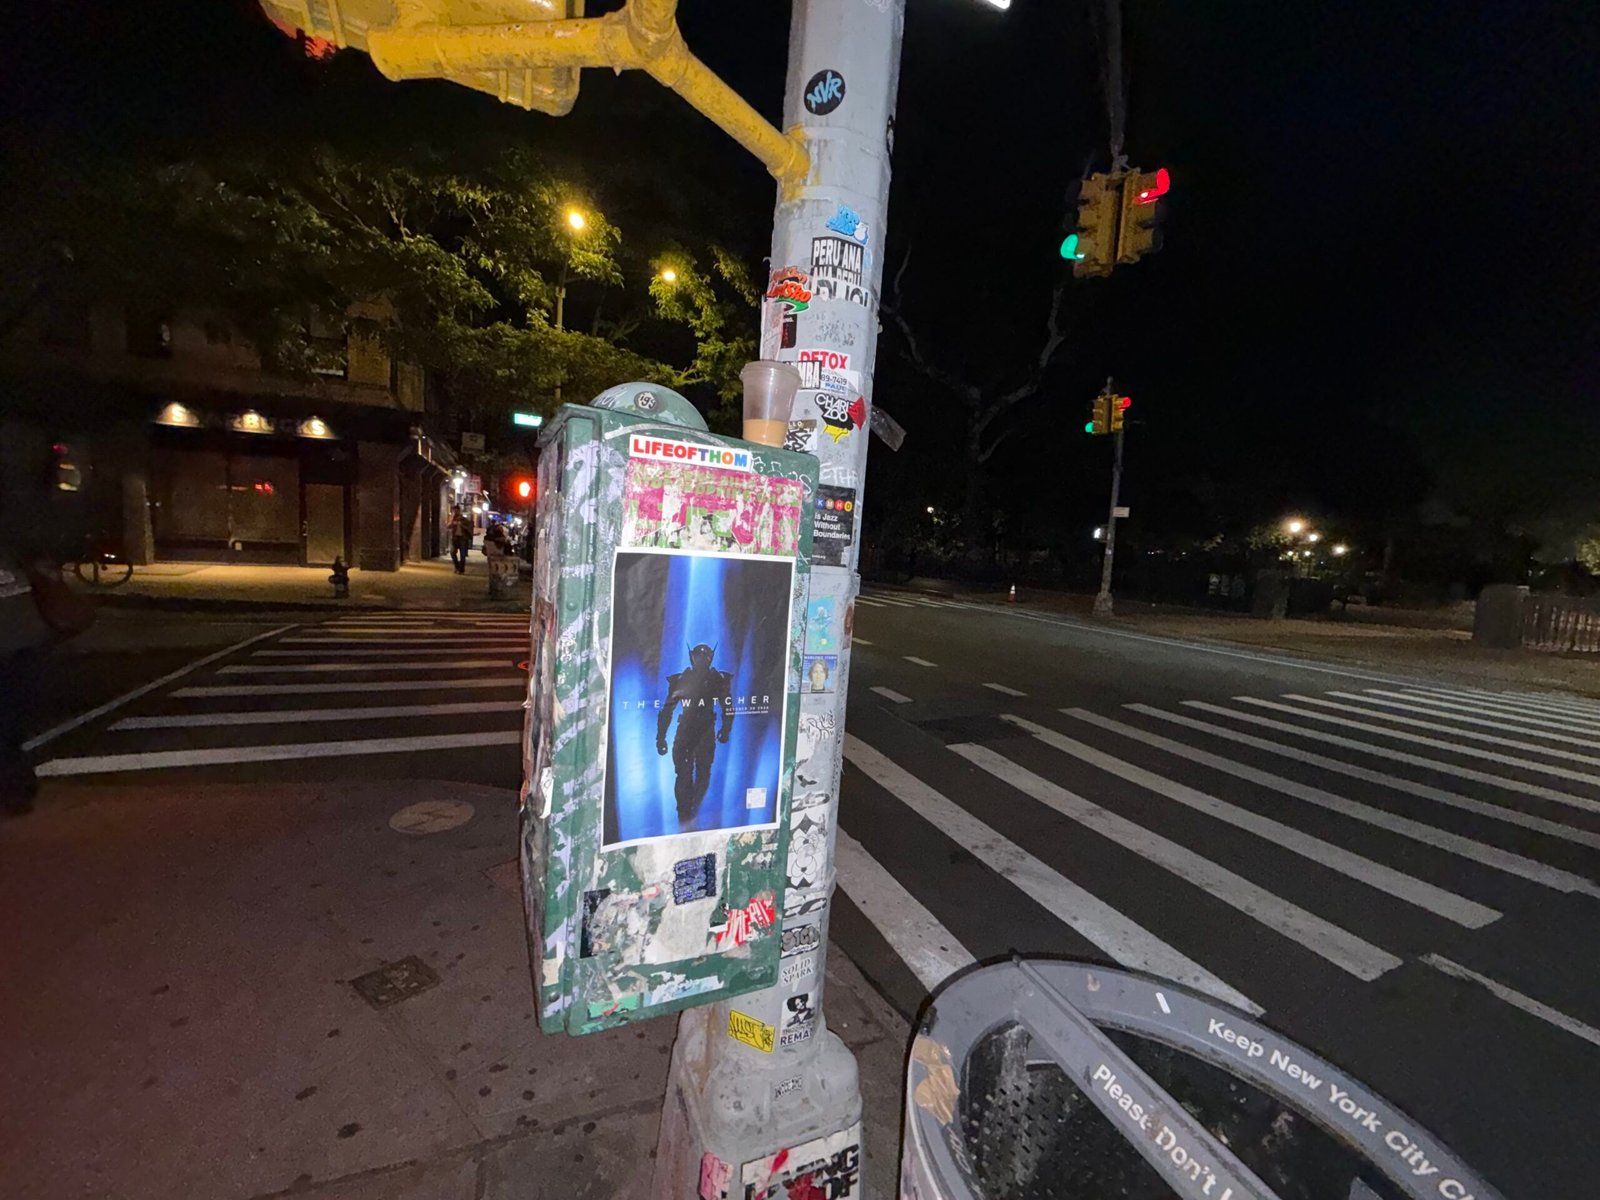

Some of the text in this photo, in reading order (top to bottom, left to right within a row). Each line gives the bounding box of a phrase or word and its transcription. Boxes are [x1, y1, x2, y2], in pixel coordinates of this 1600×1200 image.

[813, 239, 861, 274] PERU ANA
[800, 351, 848, 369] DETOX
[823, 407, 848, 422] ZOO
[633, 439, 748, 467] LIFEOFTHOM
[822, 513, 838, 521] Jazz
[814, 521, 841, 530] Without
[813, 529, 851, 540] Boundaries
[623, 695, 770, 710] THE WATCHER
[782, 958, 811, 975] SOLID
[783, 967, 812, 983] SPARK
[1208, 1018, 1264, 1057] Keep
[1269, 1049, 1322, 1090] New
[1329, 1084, 1382, 1132] York
[1385, 1130, 1439, 1176] City
[1155, 1125, 1217, 1195] Don't
